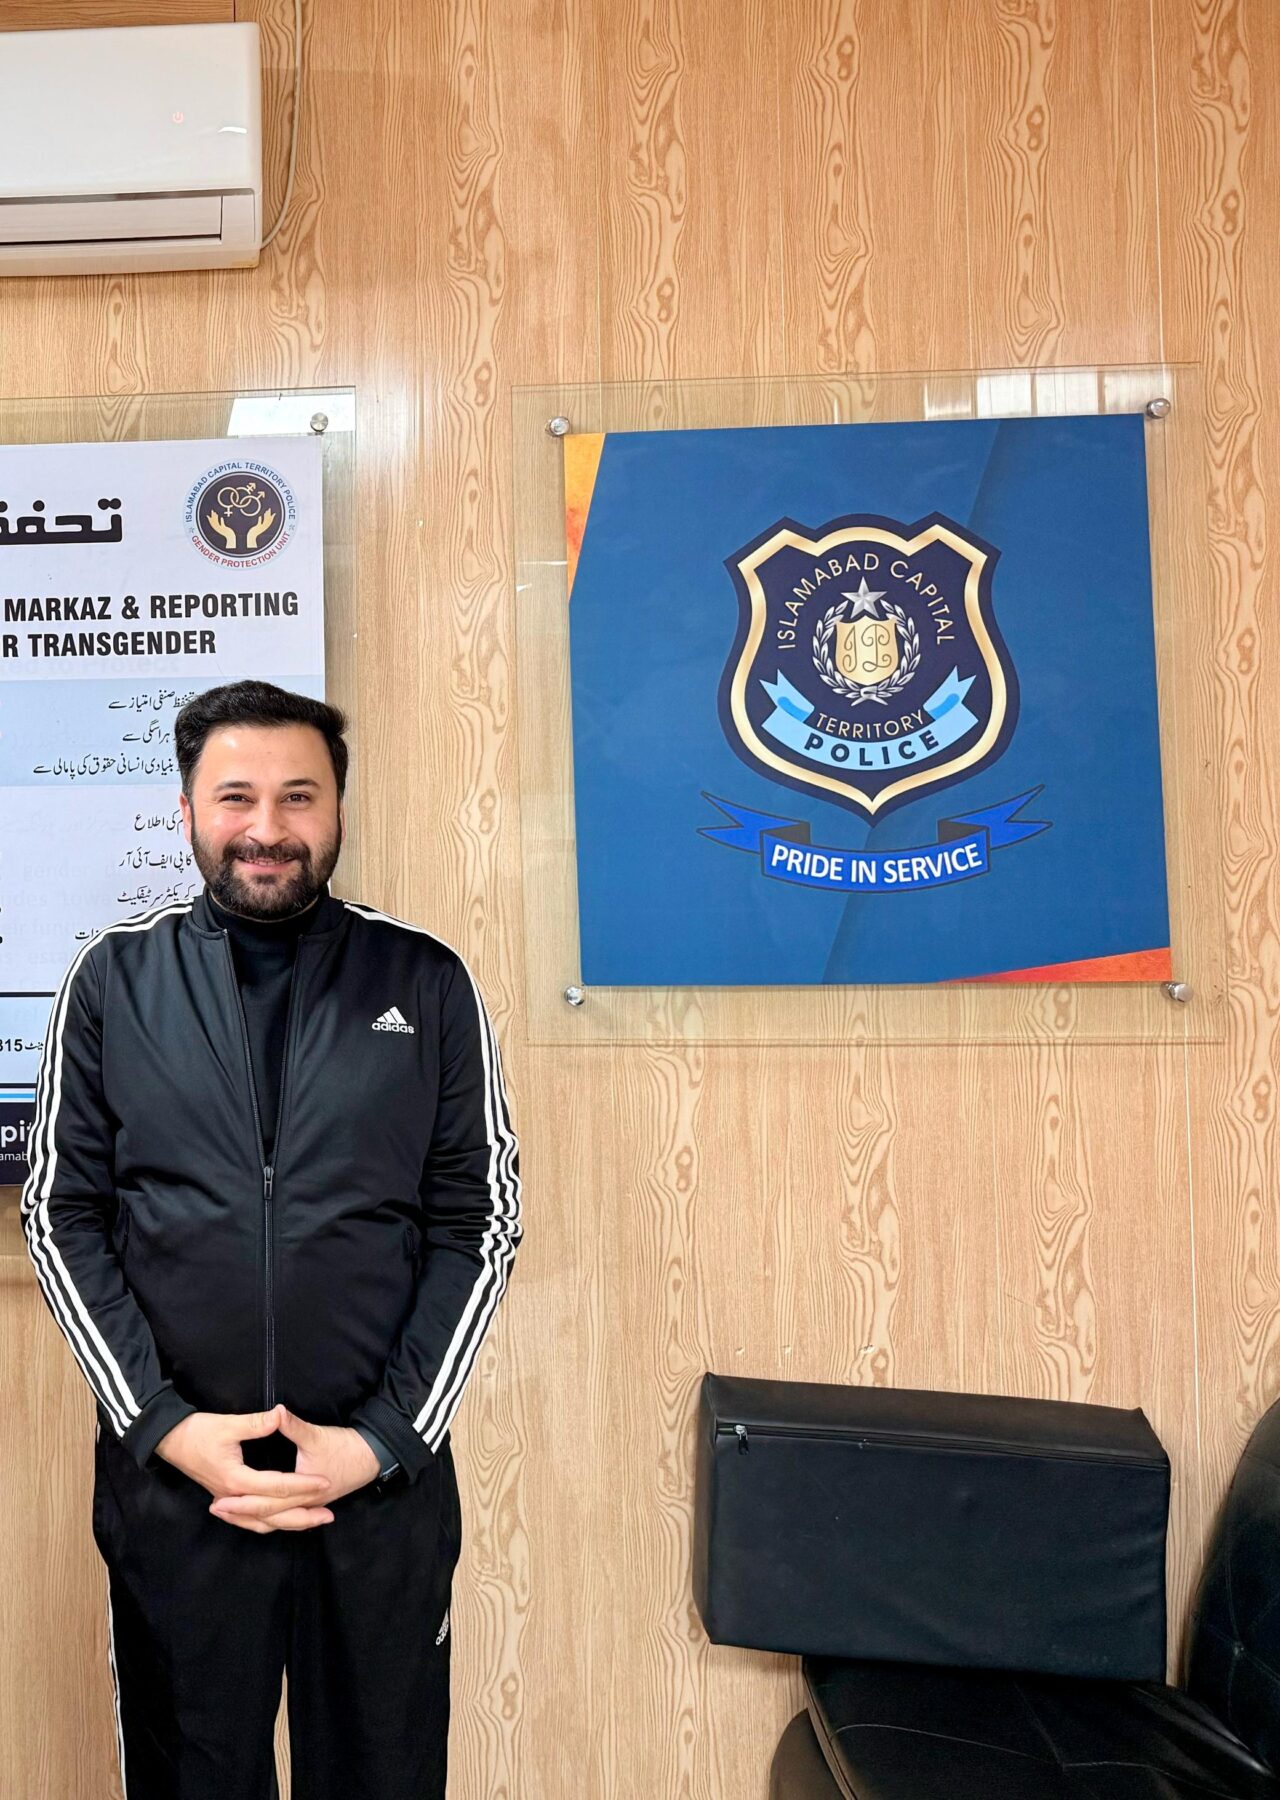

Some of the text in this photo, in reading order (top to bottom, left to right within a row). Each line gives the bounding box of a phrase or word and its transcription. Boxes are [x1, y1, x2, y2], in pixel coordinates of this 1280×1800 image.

[186, 462, 296, 522] ISLAMABAD CAPITAL TERRITORY POLICE
[192, 531, 290, 568] GENDER PROTECTION UNIT
[5, 597, 111, 621] MARKAZ
[122, 596, 140, 619] &
[151, 592, 298, 618] REPORTING
[777, 553, 955, 649] ISLAMABAD CAPITAL
[28, 631, 216, 657] TRANSGENDER
[108, 700, 127, 709] سے
[129, 694, 152, 713] امتیاز
[153, 689, 175, 710] صنفی
[816, 709, 924, 739] TERRITORY
[122, 732, 141, 742] سے
[804, 730, 939, 767] POLICE
[33, 765, 52, 774] سے
[53, 757, 76, 780] پامالی
[77, 753, 91, 776] کی
[88, 756, 116, 775] حقوق
[116, 752, 144, 775] انسانی
[134, 813, 165, 831] اطلاع
[166, 809, 180, 831] کی
[119, 850, 133, 867] آر
[148, 853, 173, 869] ایف
[772, 844, 982, 883] PRIDE IN SERVICE
[371, 1022, 415, 1034] adidas
